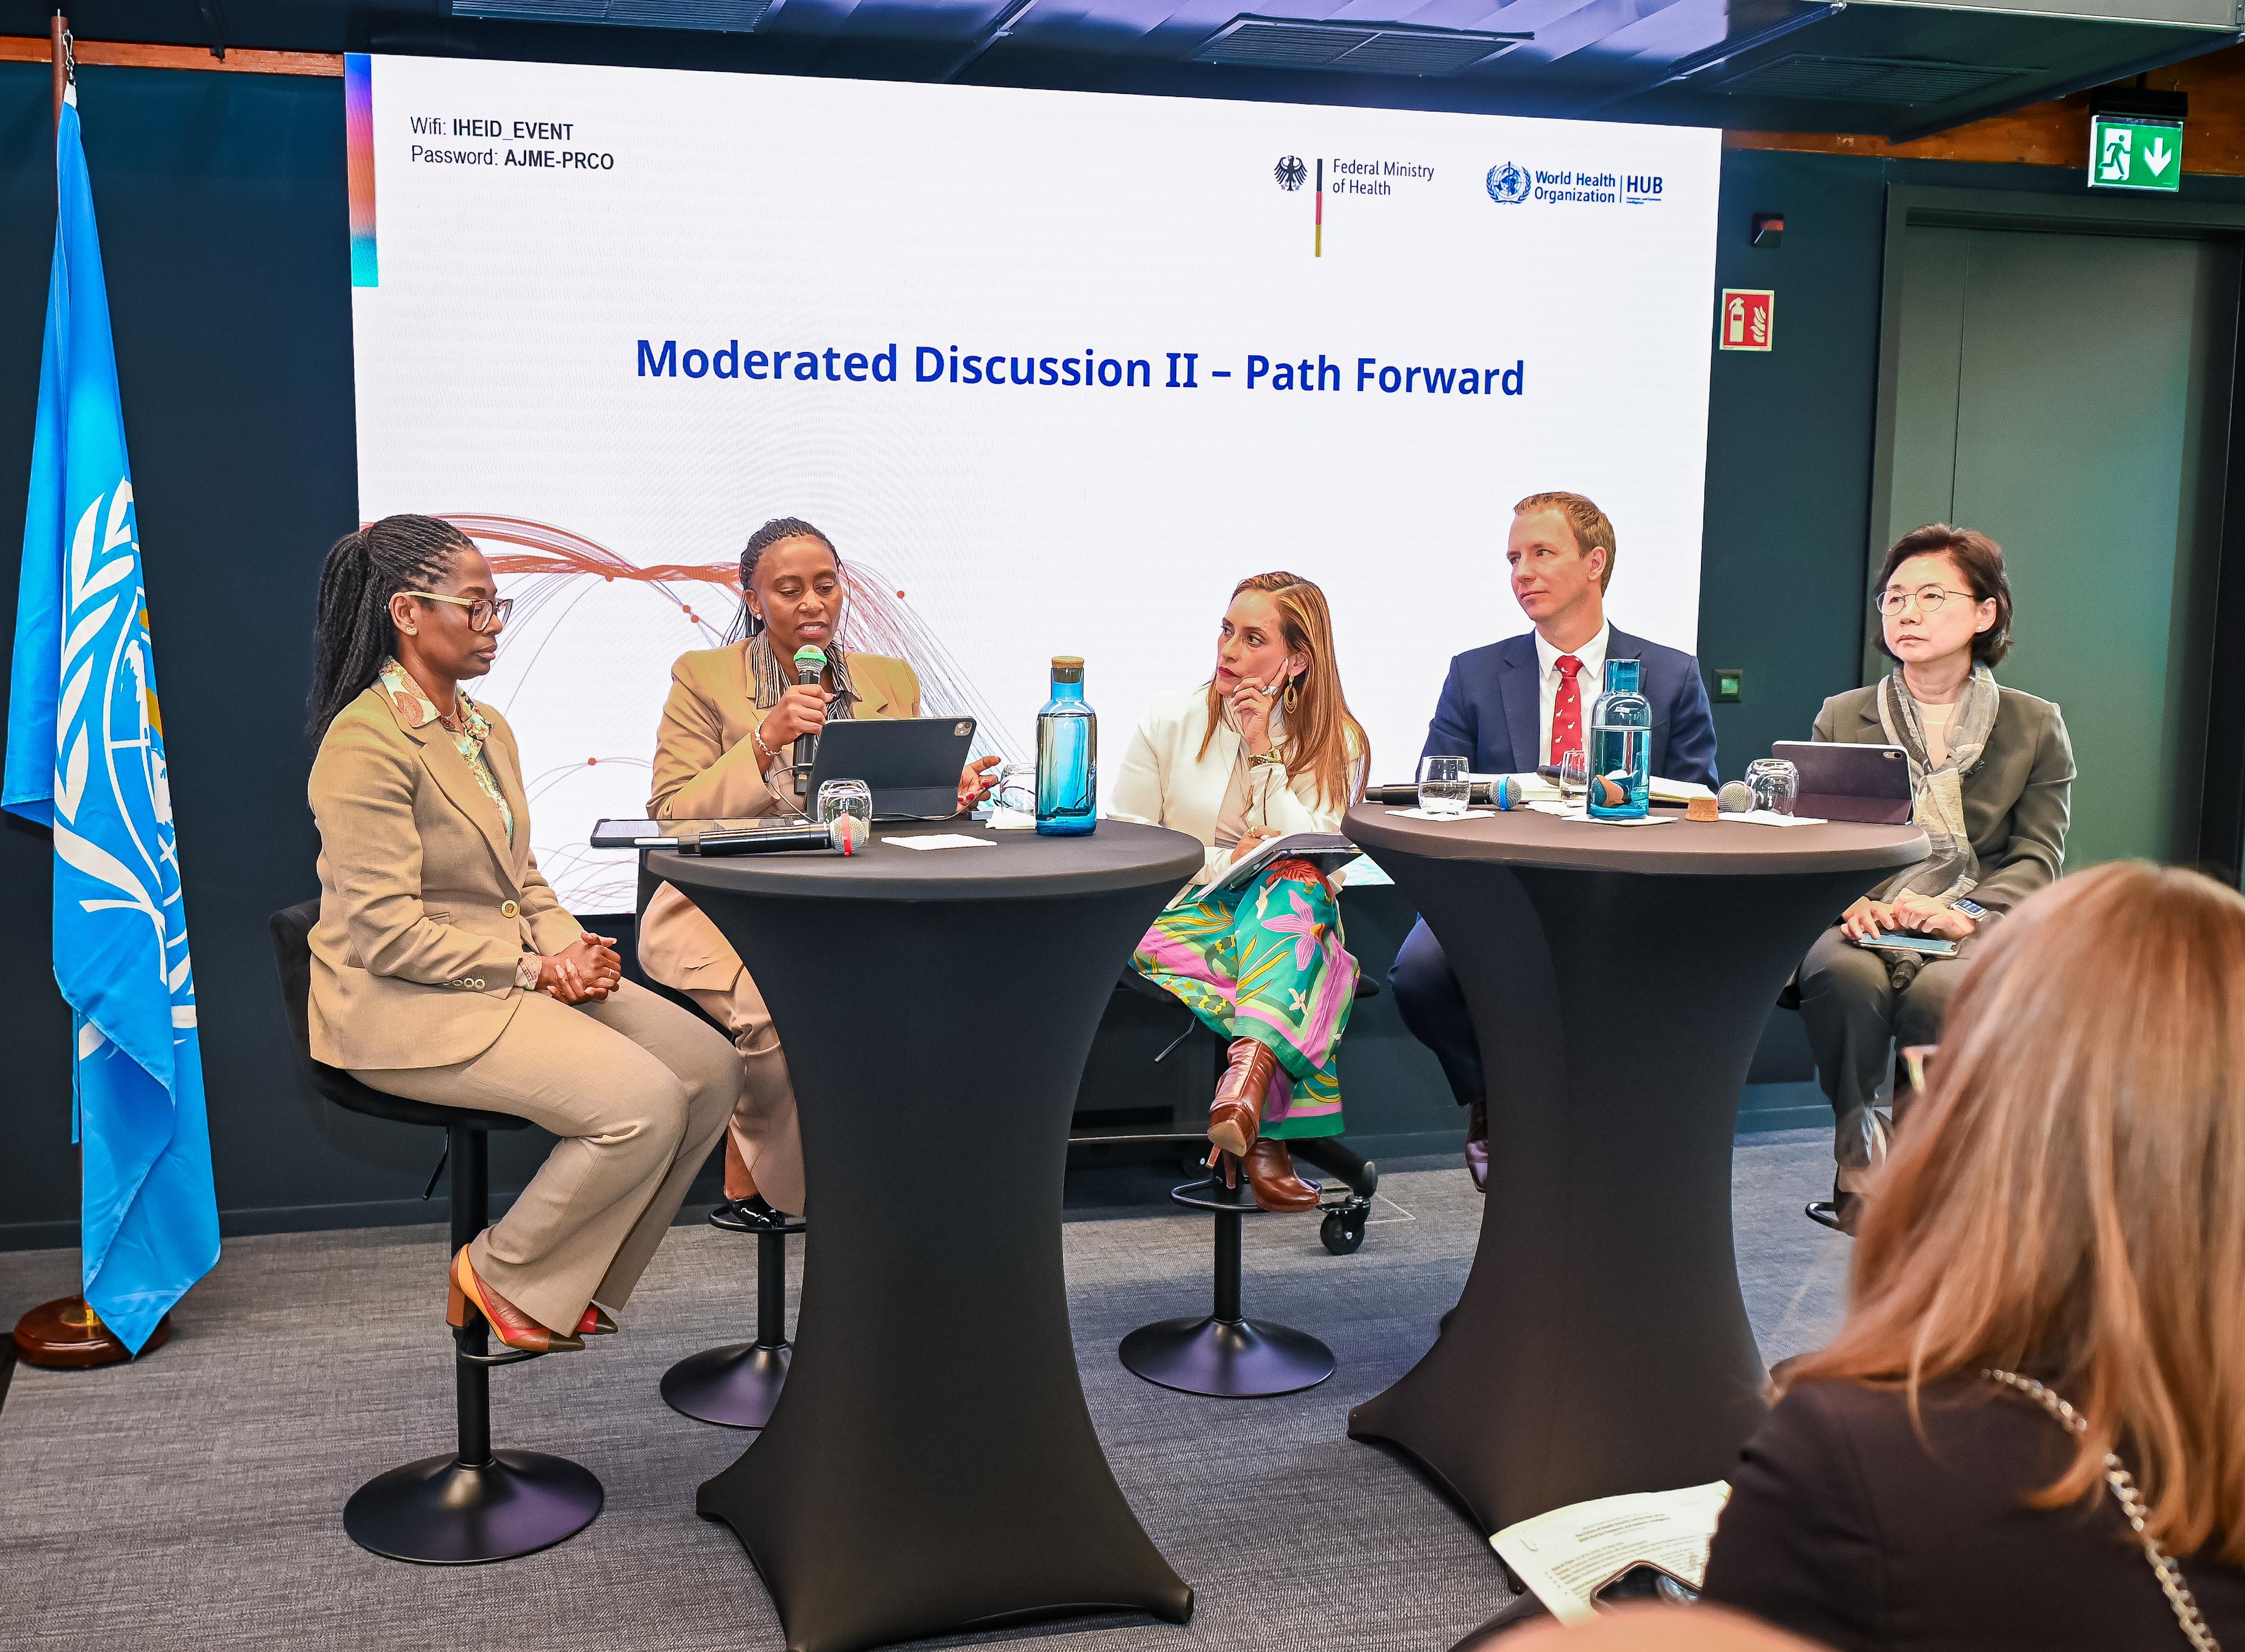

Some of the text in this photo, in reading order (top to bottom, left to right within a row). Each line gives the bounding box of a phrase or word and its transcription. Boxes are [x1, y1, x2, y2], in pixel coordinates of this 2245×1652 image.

[410, 116, 574, 141] Wifi: IHEID_EVENT
[412, 145, 614, 170] Password: AJME-PRCO
[1334, 158, 1435, 182] Federal Ministry
[1535, 171, 1616, 187] World Health
[1332, 178, 1391, 195] of Health
[1627, 175, 1663, 194] HUB
[1534, 187, 1615, 204] Organization
[637, 339, 896, 382] Moderated
[916, 345, 1150, 387] Discussion
[1165, 352, 1198, 388] II
[1247, 355, 1340, 391] Path
[1357, 358, 1523, 396] Forward
